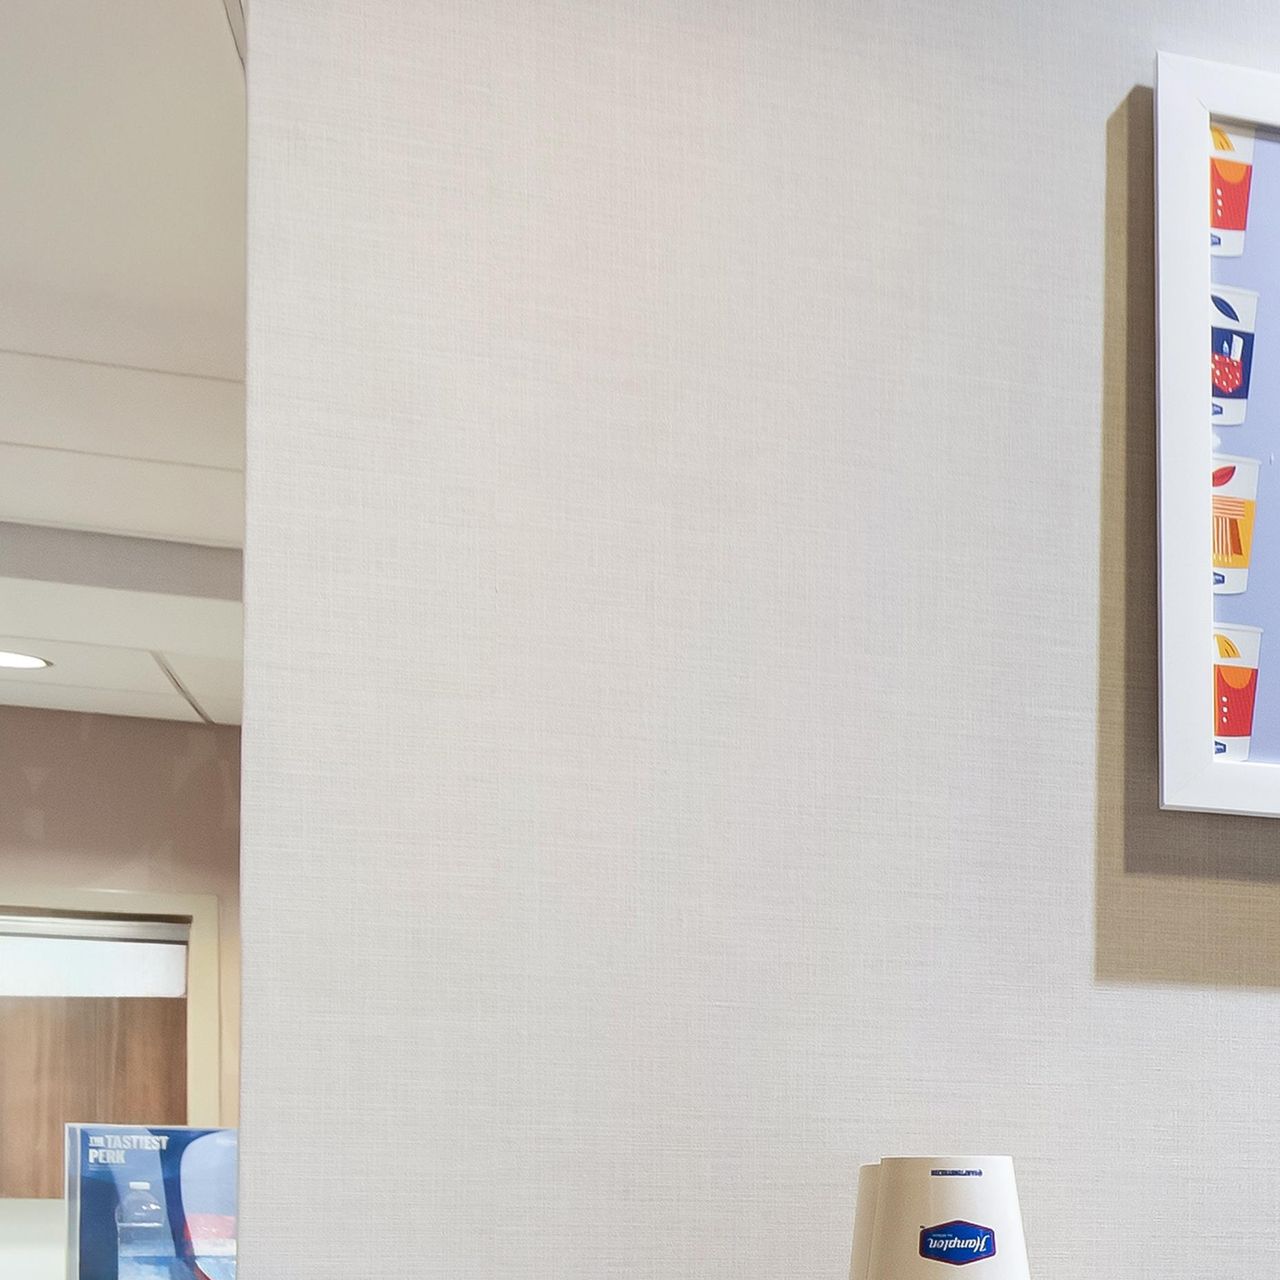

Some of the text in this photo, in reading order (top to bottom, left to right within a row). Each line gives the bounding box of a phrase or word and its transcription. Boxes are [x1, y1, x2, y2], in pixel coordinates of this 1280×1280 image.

[104, 1134, 169, 1150] TASTIEST
[88, 1148, 126, 1164] PERK
[927, 1234, 991, 1253] Hampton
